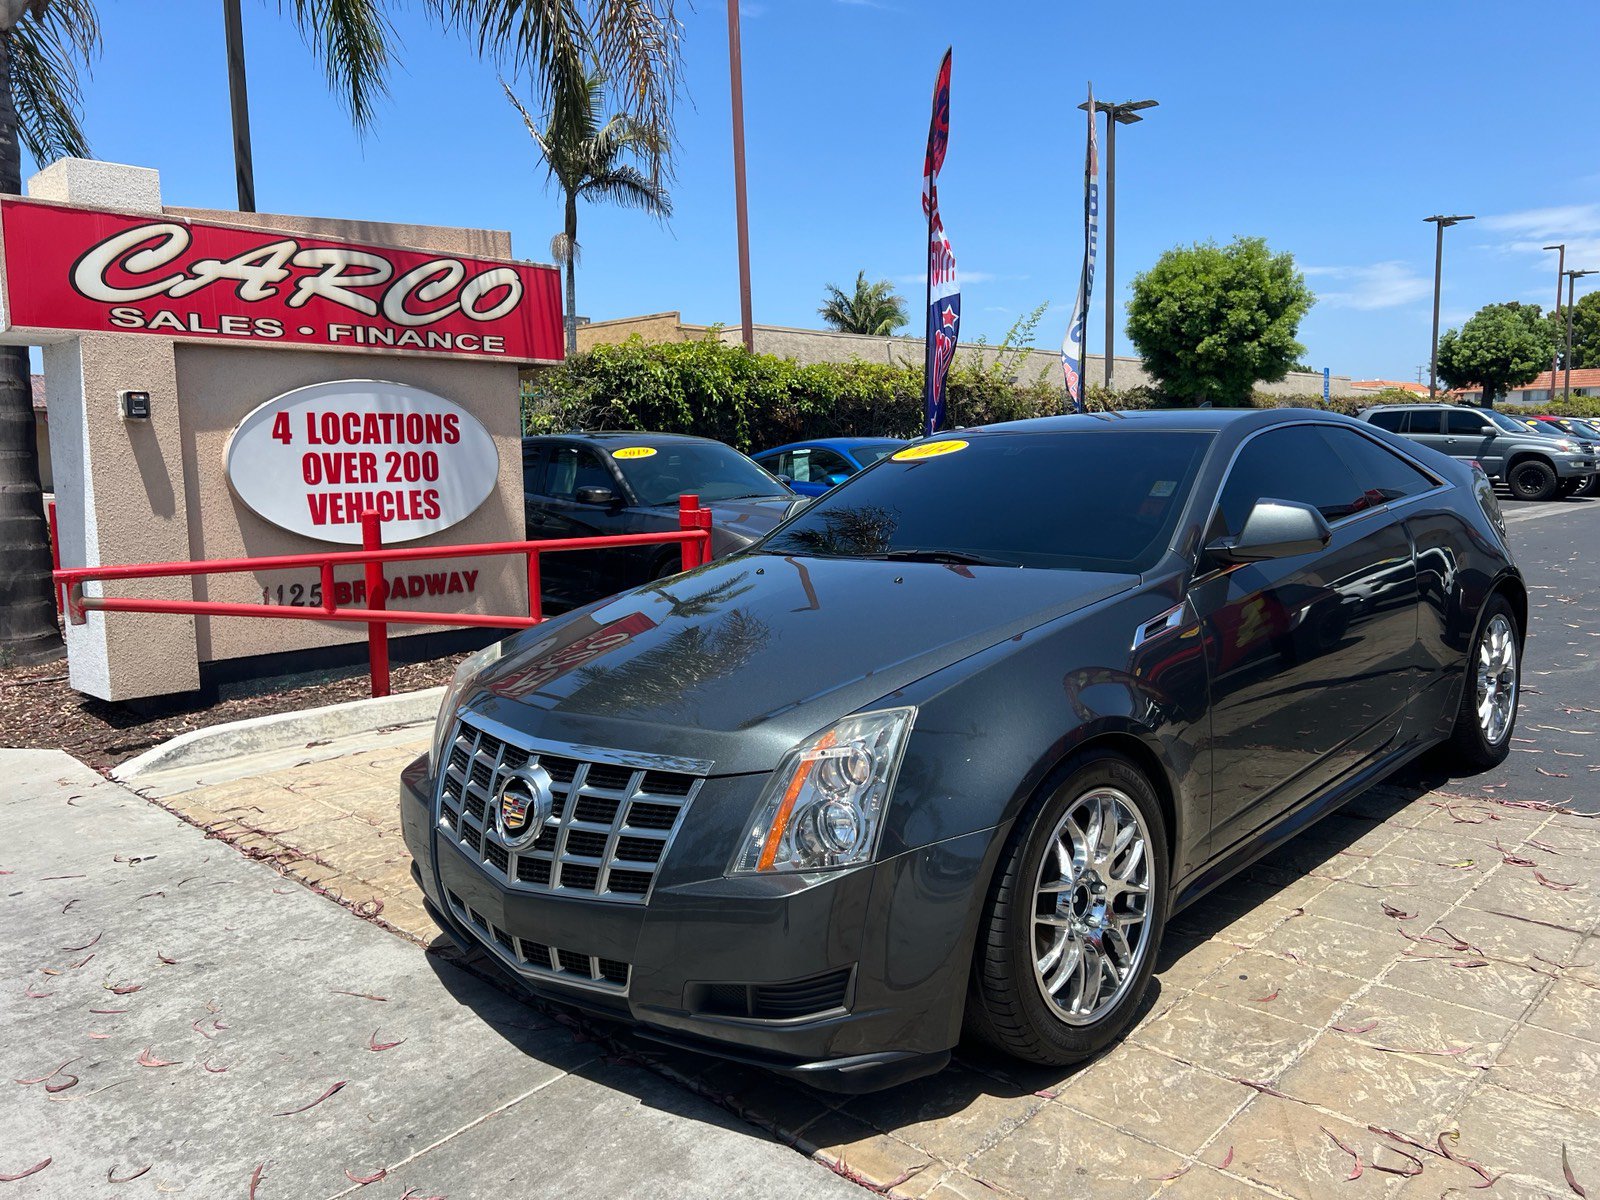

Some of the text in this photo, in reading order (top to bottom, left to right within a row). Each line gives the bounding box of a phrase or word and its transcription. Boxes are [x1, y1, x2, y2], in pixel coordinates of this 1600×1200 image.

[70, 223, 524, 326] CARCO
[110, 307, 506, 353] SALES FINANCE
[272, 412, 461, 445] 4 LOCATIONS
[302, 450, 440, 486] OVER 200
[622, 448, 649, 458] 2019
[306, 488, 442, 526] VEHICLES
[262, 583, 323, 607] 1125
